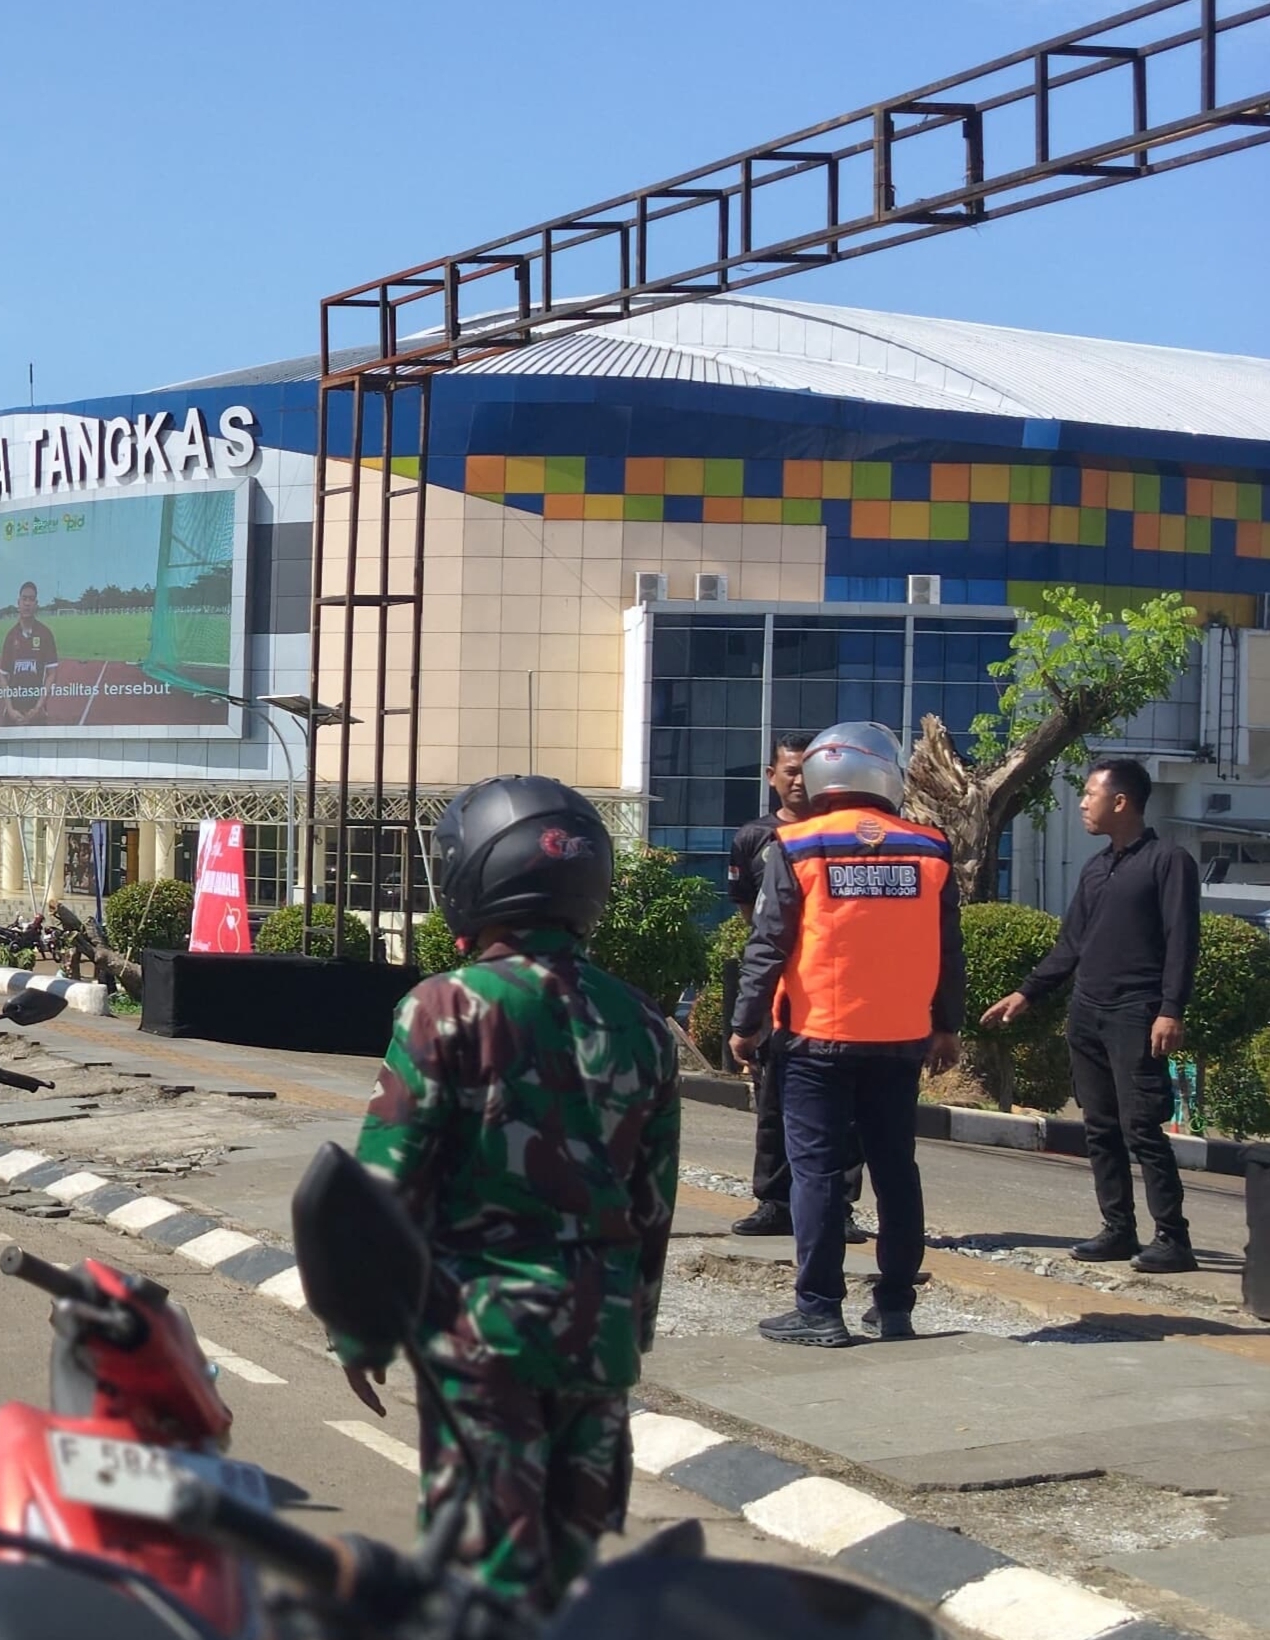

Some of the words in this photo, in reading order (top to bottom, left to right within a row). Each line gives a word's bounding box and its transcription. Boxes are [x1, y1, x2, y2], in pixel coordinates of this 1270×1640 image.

[25, 405, 255, 489] TANGKAS
[51, 683, 100, 698] fasilitas
[104, 681, 171, 696] tersebut
[829, 865, 917, 887] DISHUB
[831, 887, 883, 896] KABUPATEN
[885, 887, 917, 896] BOGOR
